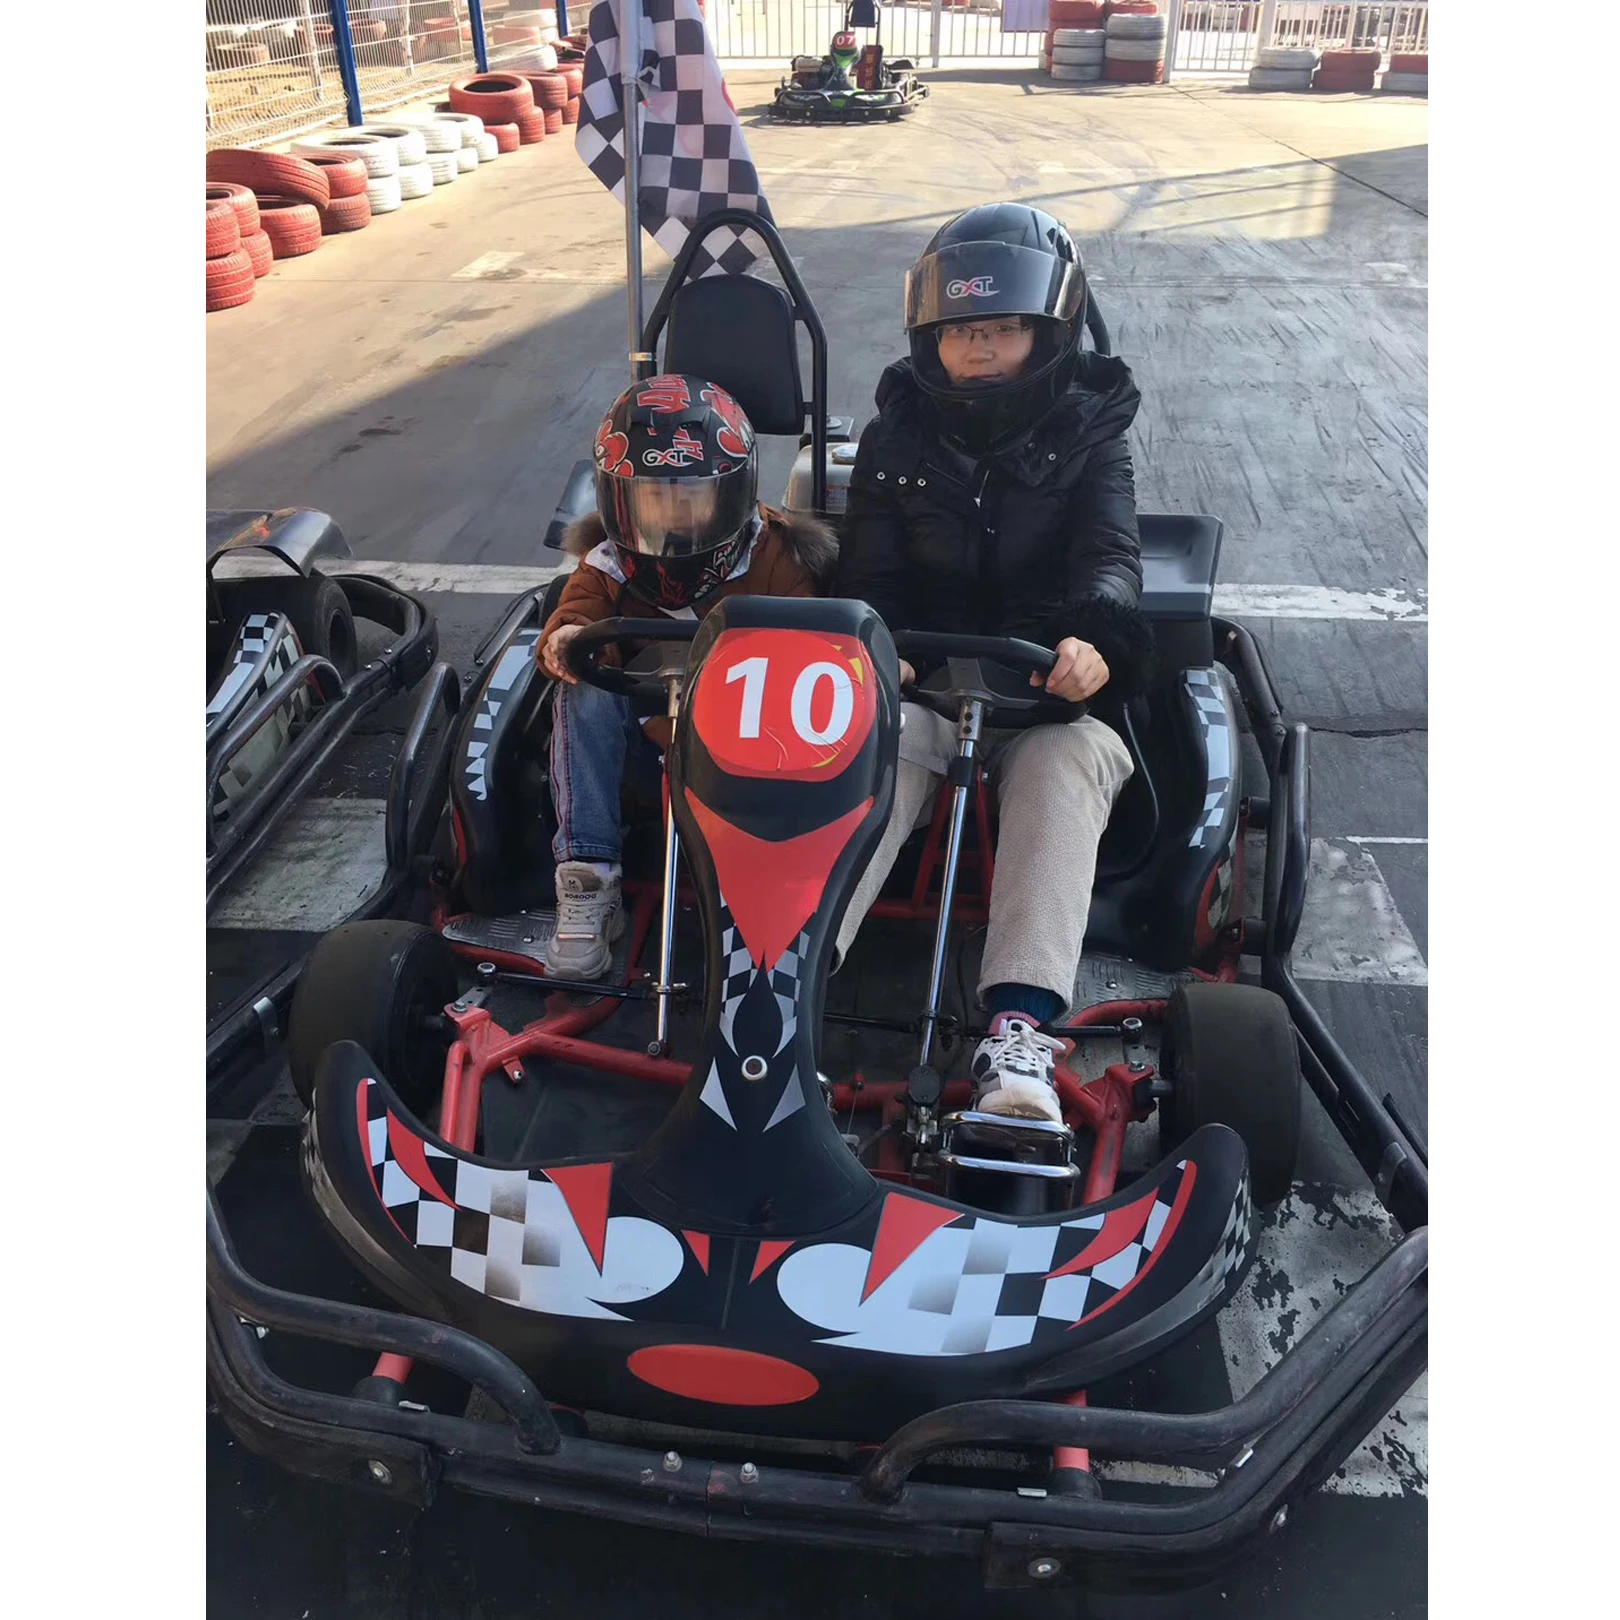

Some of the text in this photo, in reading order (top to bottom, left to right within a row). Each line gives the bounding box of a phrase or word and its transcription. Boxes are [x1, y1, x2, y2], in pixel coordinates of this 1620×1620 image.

[836, 35, 854, 45] 07
[946, 275, 1000, 299] GXT
[642, 448, 693, 467] GXT
[725, 656, 854, 746] 10
